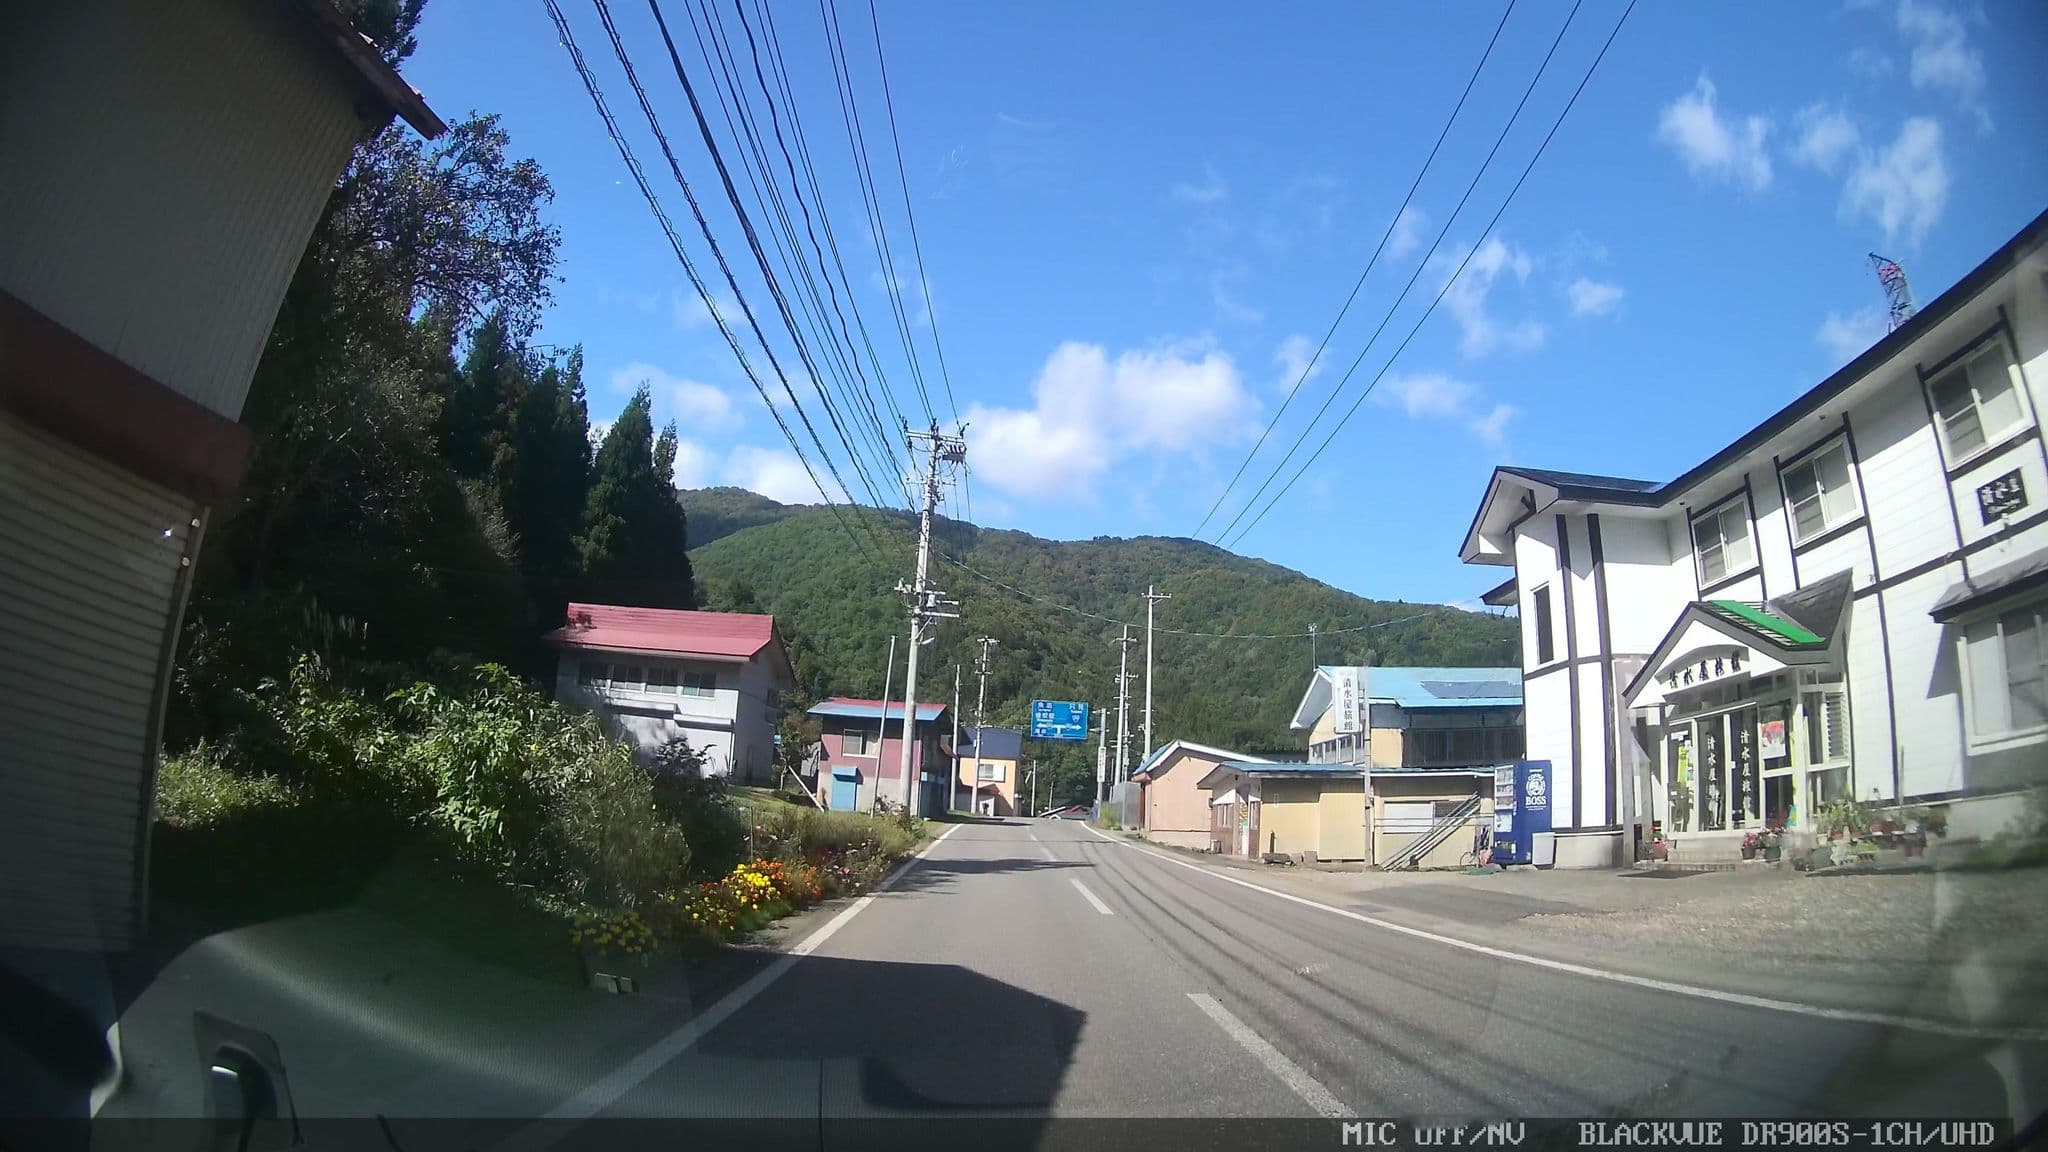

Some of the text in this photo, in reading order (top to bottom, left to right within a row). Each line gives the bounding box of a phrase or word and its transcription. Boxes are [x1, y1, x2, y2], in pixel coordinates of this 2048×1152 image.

[1343, 678, 1353, 731] 清水屋旅館
[1525, 796, 1547, 806] BOSS
